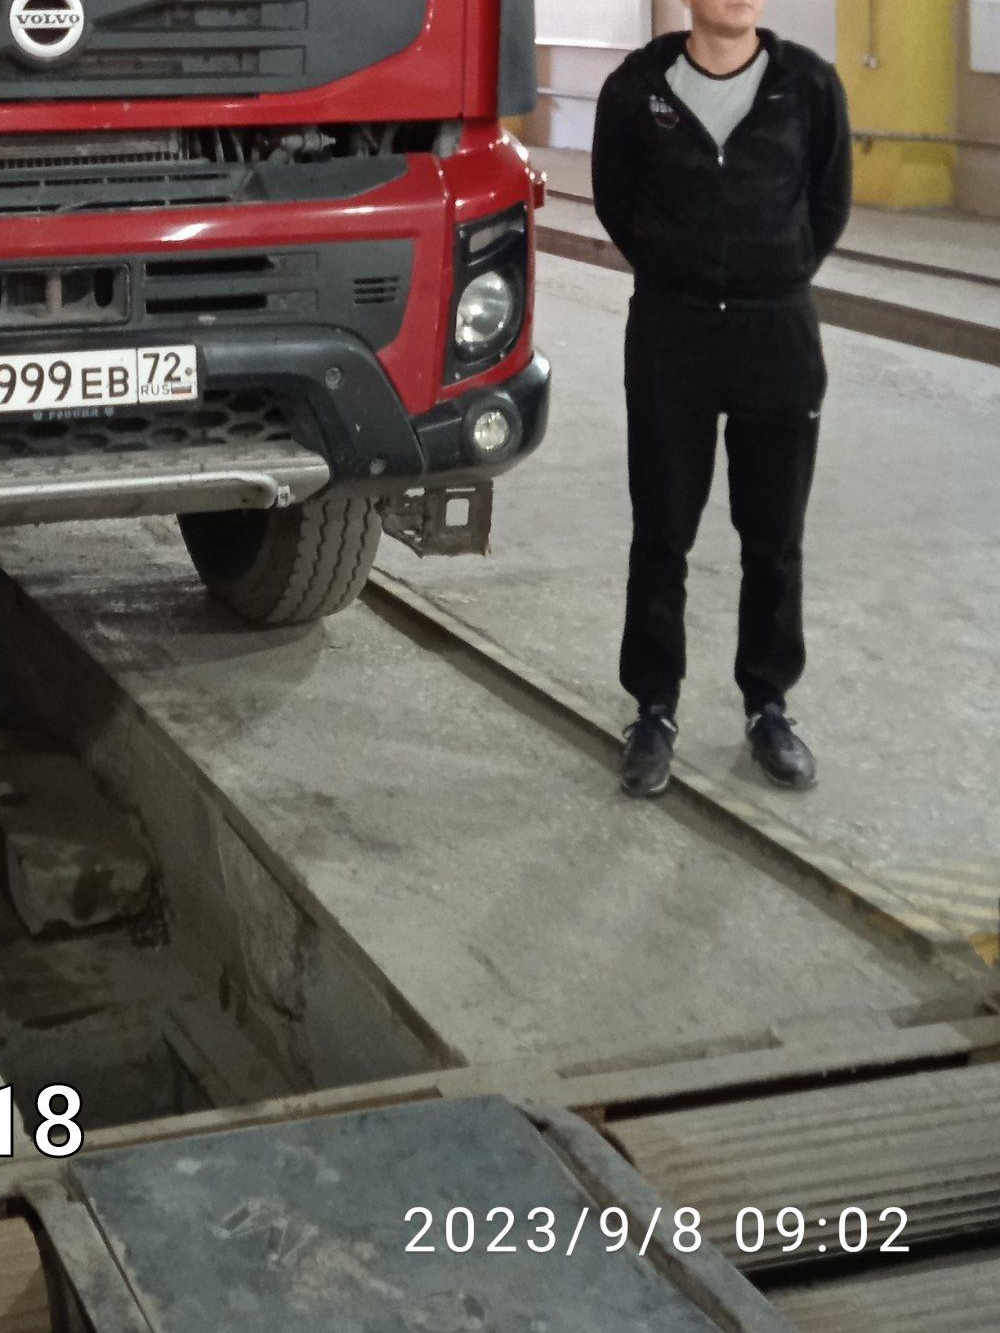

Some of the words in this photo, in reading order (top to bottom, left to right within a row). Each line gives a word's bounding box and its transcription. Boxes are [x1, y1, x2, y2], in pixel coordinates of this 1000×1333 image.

[15, 13, 80, 24] VOLVO
[142, 352, 181, 384] 72
[140, 383, 171, 396] RUS
